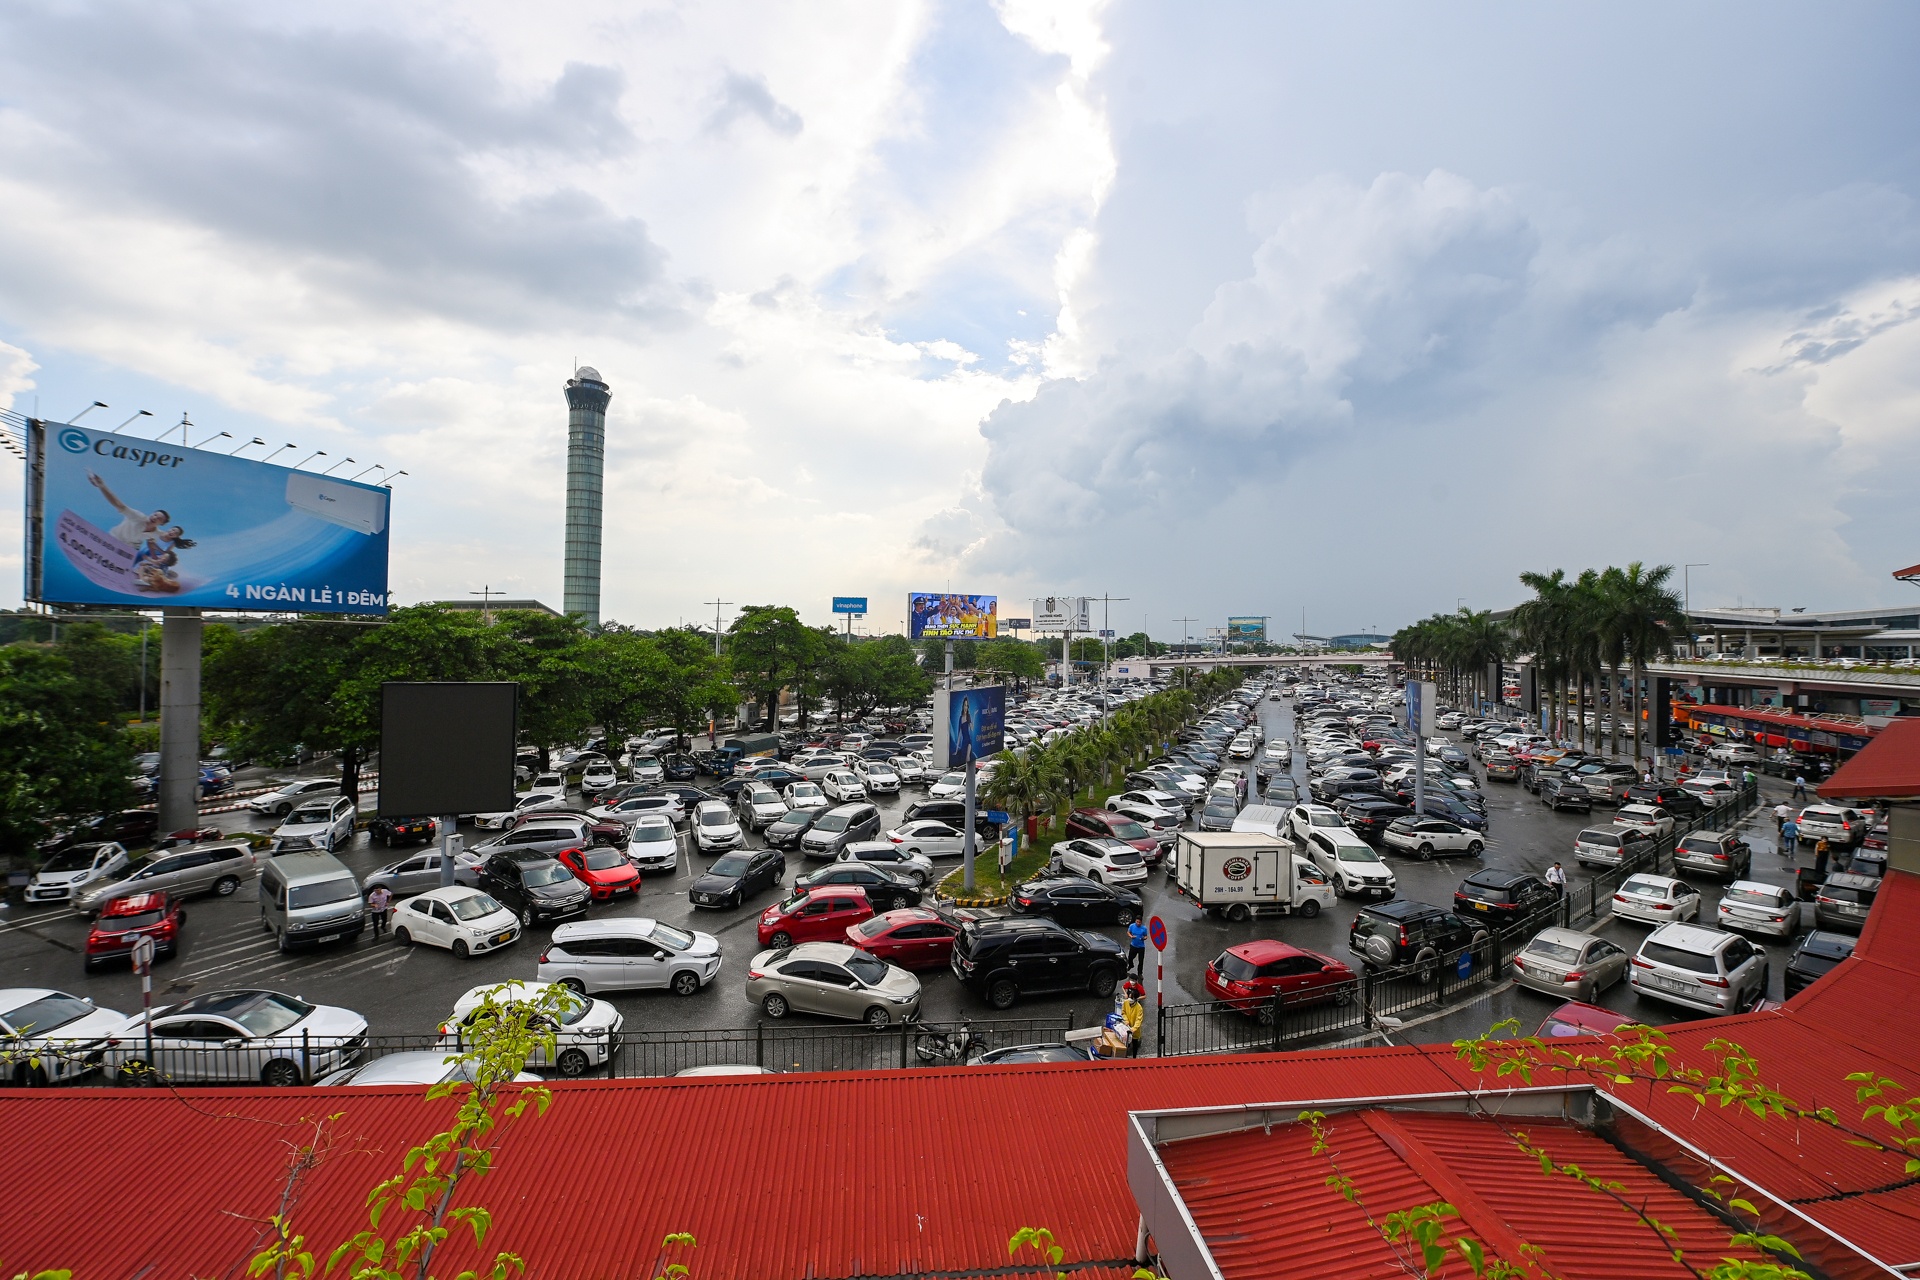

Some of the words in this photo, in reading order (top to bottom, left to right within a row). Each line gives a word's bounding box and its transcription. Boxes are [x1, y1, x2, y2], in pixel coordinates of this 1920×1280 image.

[93, 438, 184, 468] Casper
[226, 583, 240, 598] 4
[246, 583, 305, 602] NGÀN
[311, 585, 332, 603] LẺ
[336, 591, 343, 604] 1
[347, 589, 384, 607] ĐÊM
[1225, 858, 1250, 869] HIGHLANDS
